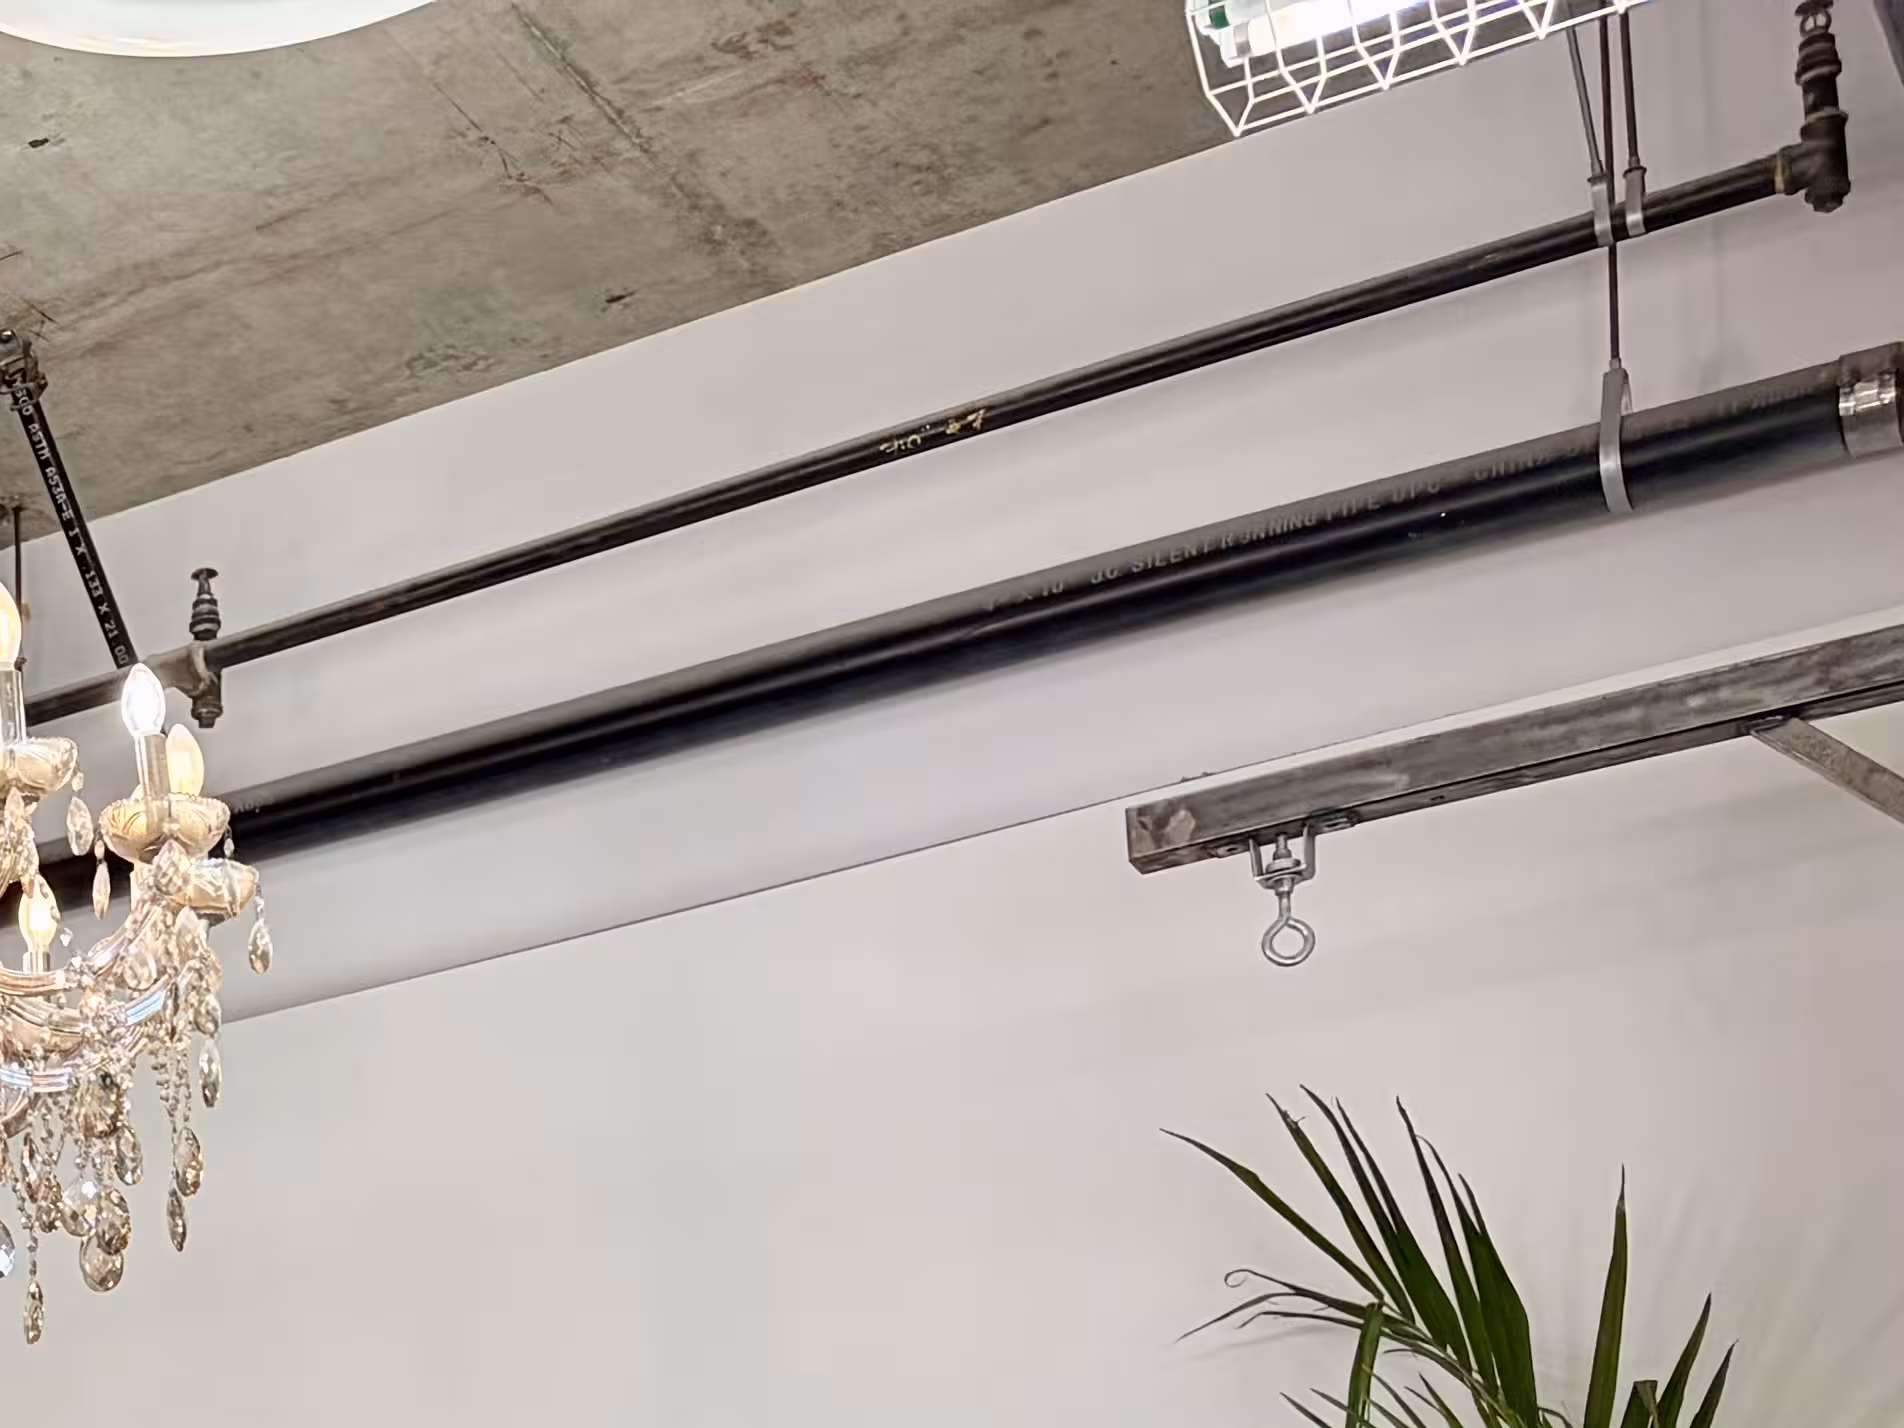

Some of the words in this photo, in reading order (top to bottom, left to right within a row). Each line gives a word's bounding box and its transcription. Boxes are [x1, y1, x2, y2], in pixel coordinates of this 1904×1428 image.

[26, 422, 51, 460] ASTM
[74, 542, 87, 555] X
[96, 601, 111, 615] X
